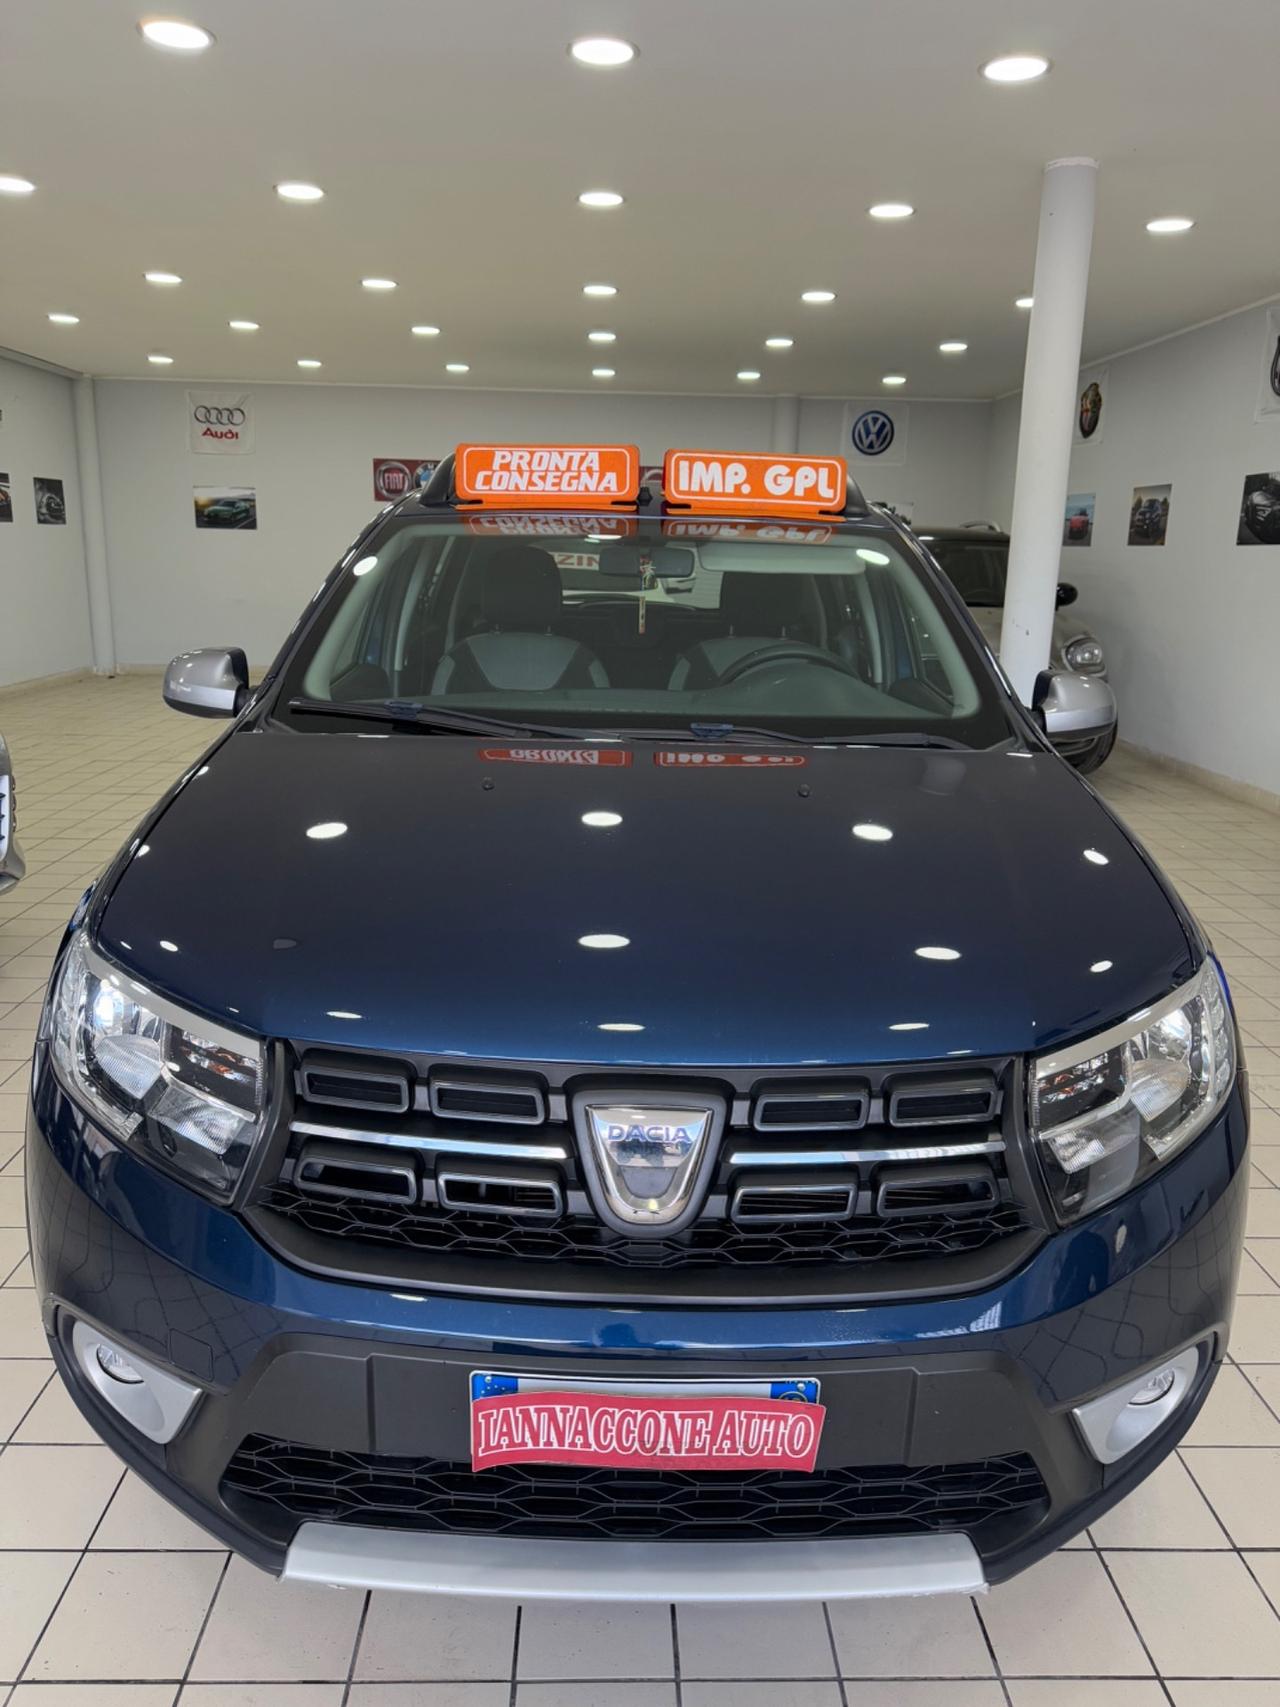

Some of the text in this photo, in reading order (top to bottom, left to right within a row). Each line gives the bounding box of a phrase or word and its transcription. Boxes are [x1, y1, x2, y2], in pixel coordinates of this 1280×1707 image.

[201, 427, 239, 440] Audi
[492, 450, 600, 471] PRONTA
[384, 472, 404, 490] FIAT
[475, 471, 618, 492] CONSEGNA
[678, 460, 834, 498] IMP. GPL
[607, 1124, 693, 1142] DACIA
[478, 1404, 815, 1458] IANNACCONE AUTO
